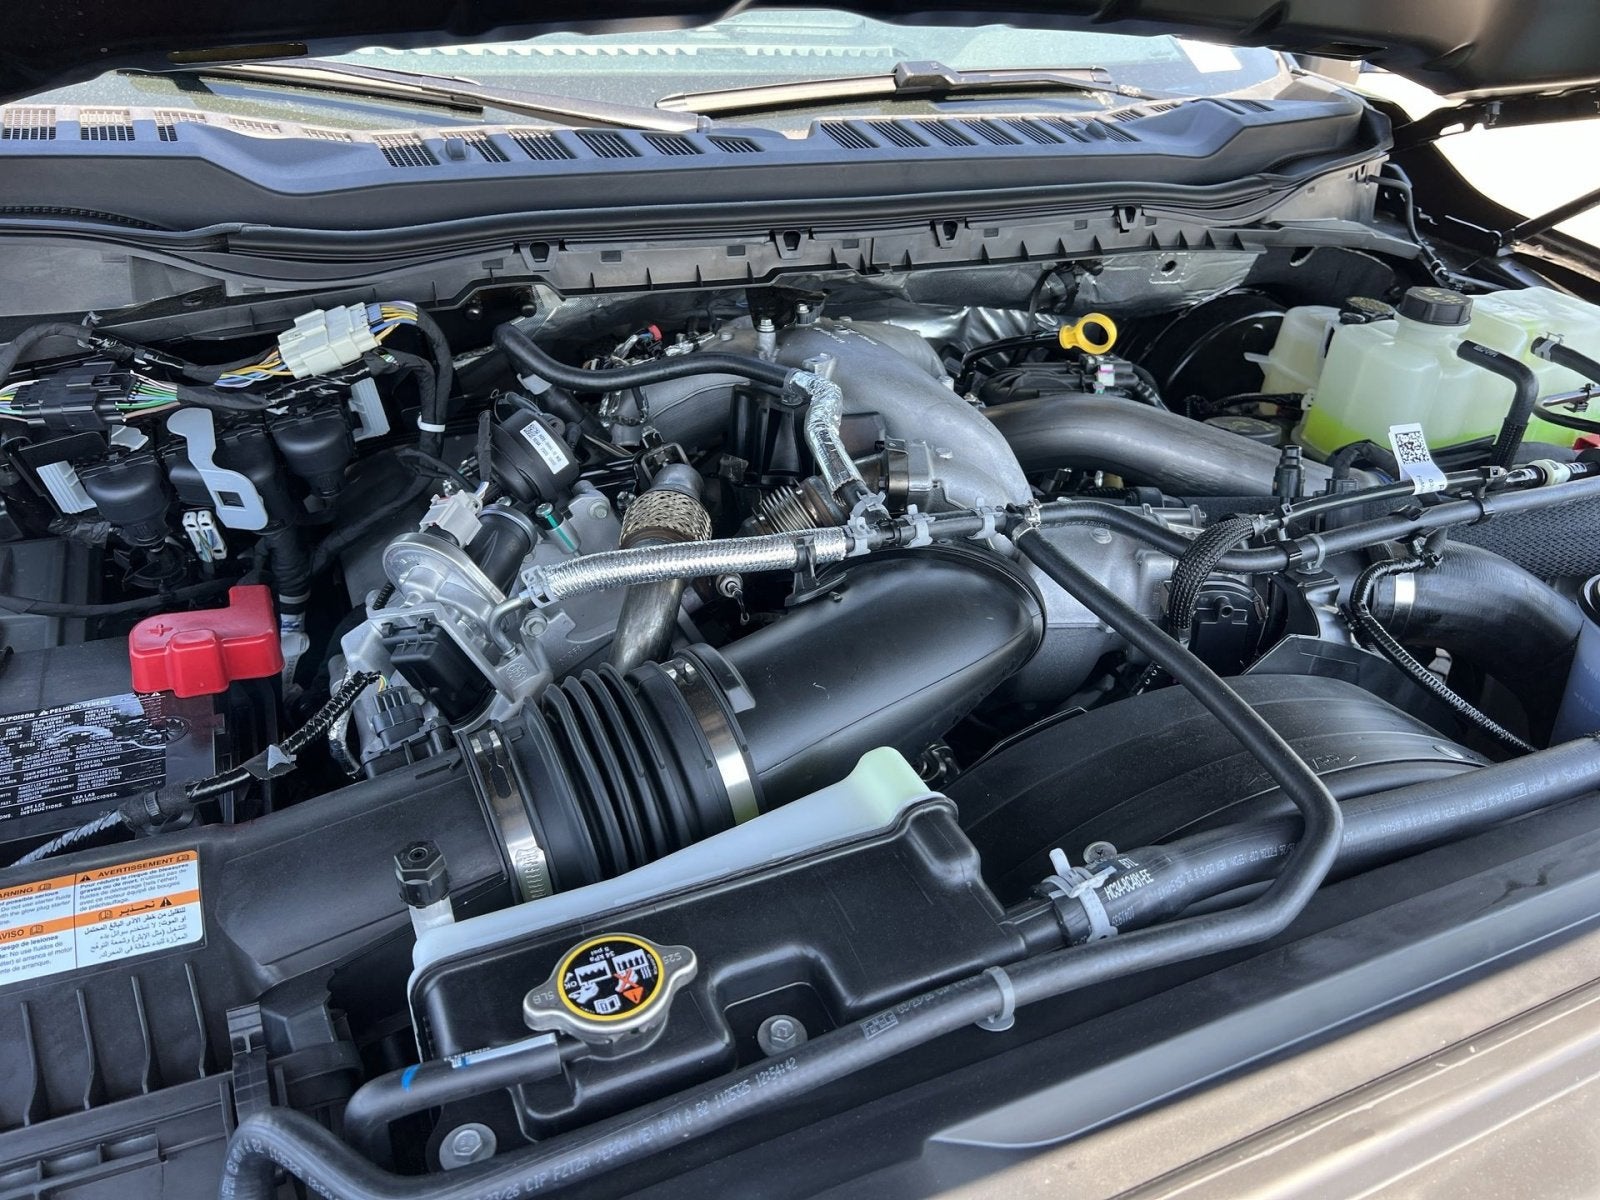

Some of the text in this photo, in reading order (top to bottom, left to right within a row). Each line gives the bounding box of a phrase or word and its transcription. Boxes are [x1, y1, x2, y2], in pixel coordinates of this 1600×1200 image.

[0, 713, 34, 722] R/POISON
[98, 858, 172, 877] AVERTISSEMENT
[0, 887, 33, 898] ARNING
[0, 929, 24, 939] VISO
[564, 980, 578, 990] OK
